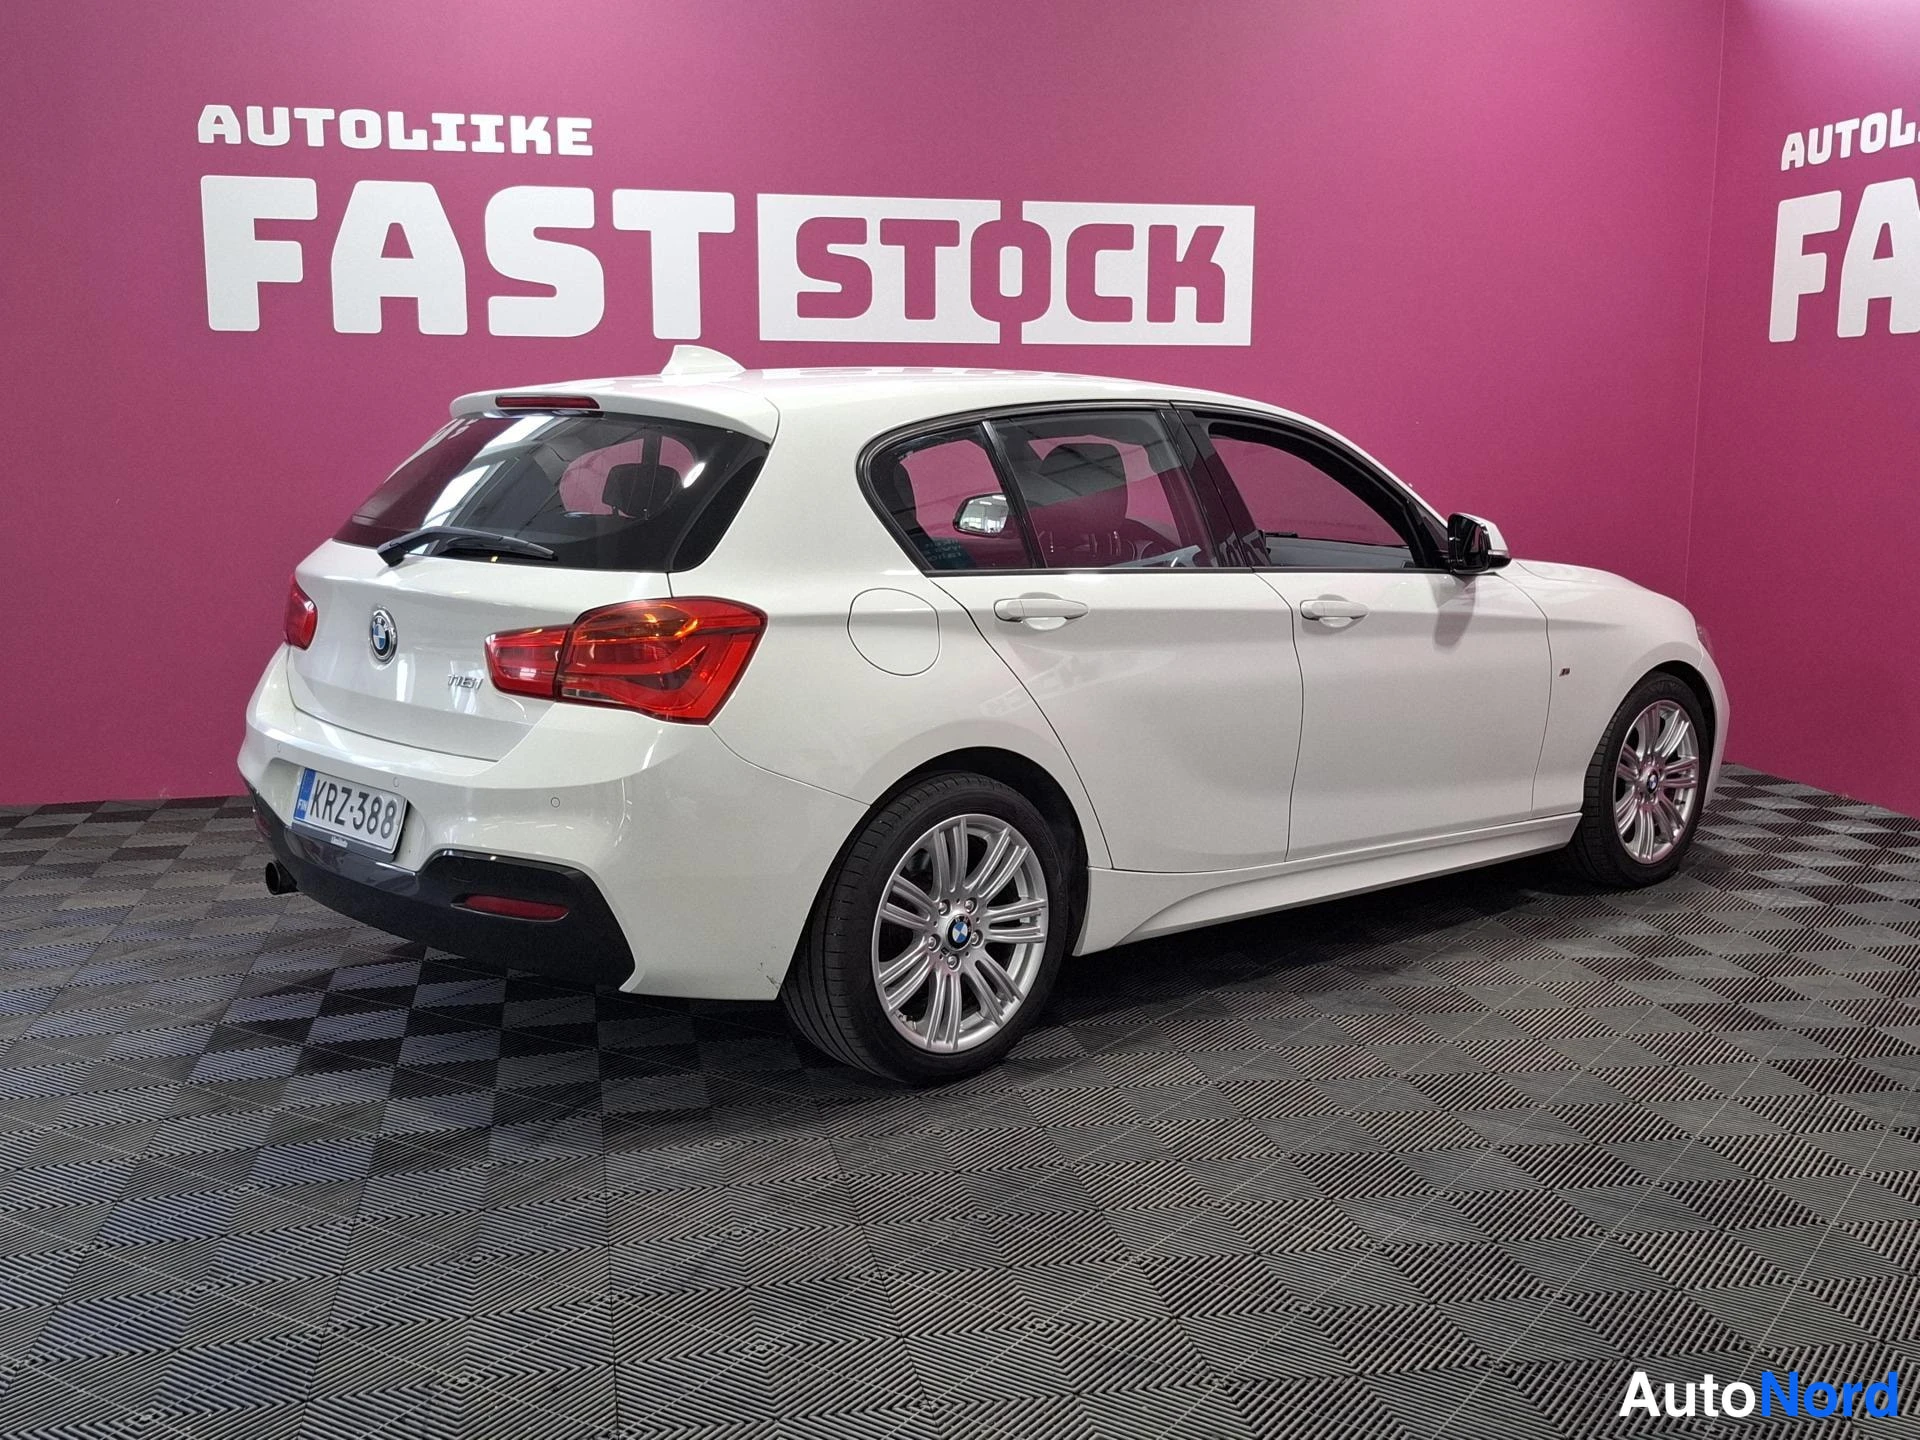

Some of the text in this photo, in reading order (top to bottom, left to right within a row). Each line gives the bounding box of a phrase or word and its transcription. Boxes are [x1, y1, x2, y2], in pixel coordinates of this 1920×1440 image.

[198, 104, 594, 156] AUTOLIIKE
[1780, 108, 1920, 171] AUTOL
[310, 779, 397, 839] KRZ-388
